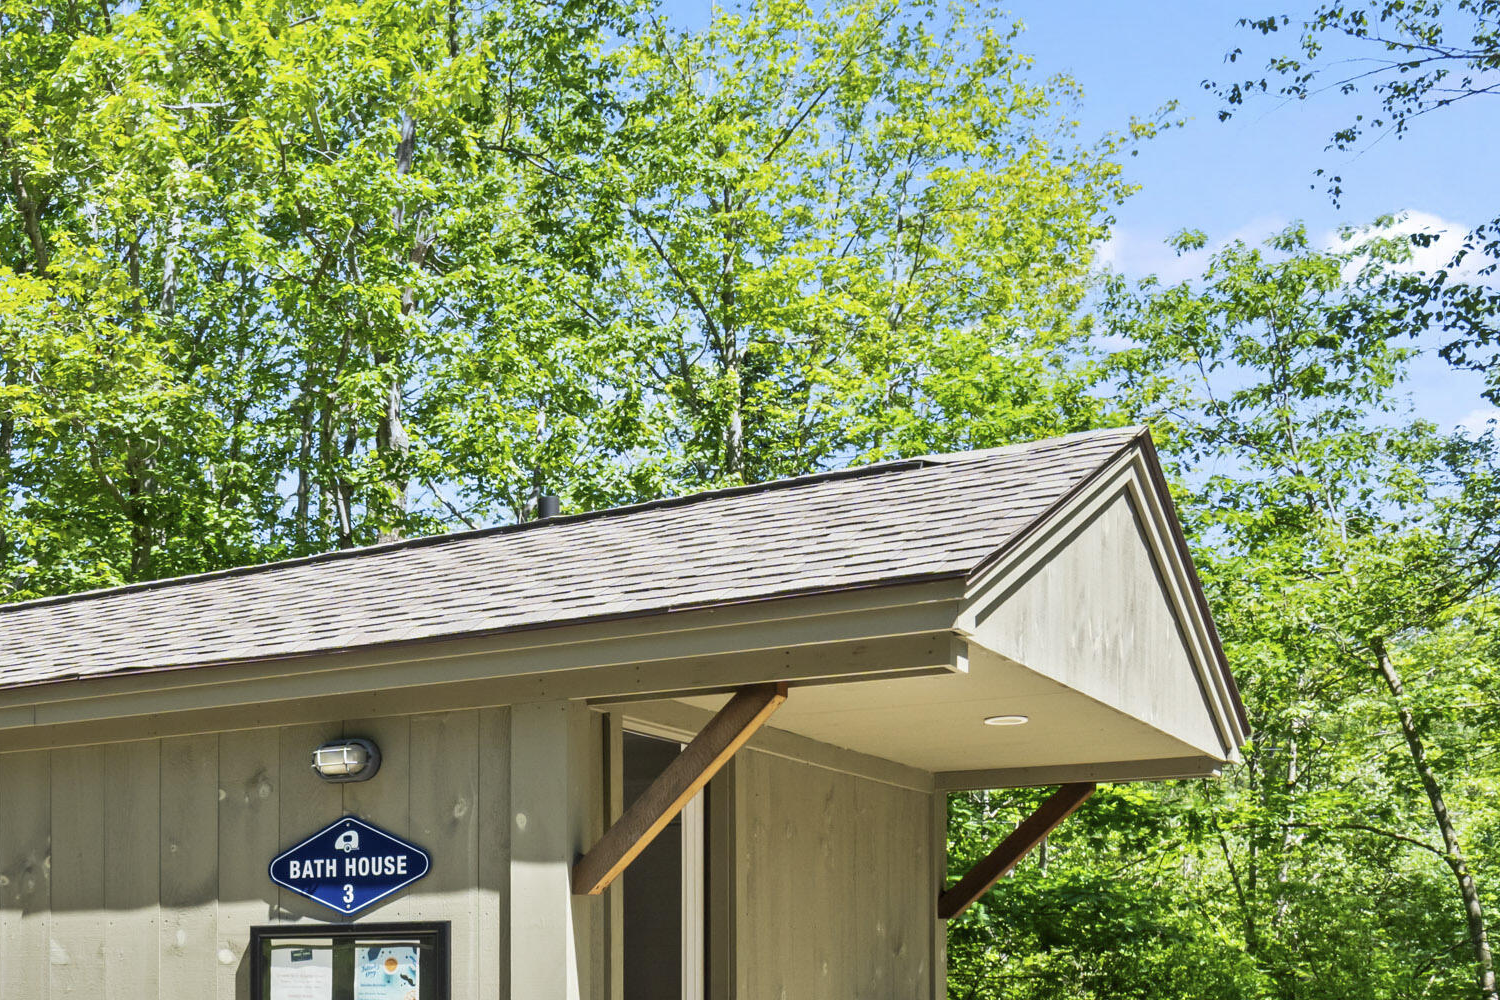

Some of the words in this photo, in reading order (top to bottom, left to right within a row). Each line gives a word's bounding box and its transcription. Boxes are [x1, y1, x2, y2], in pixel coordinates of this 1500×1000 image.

[289, 858, 337, 879] BATH
[345, 855, 408, 877] HOUSE
[342, 883, 355, 904] 3
